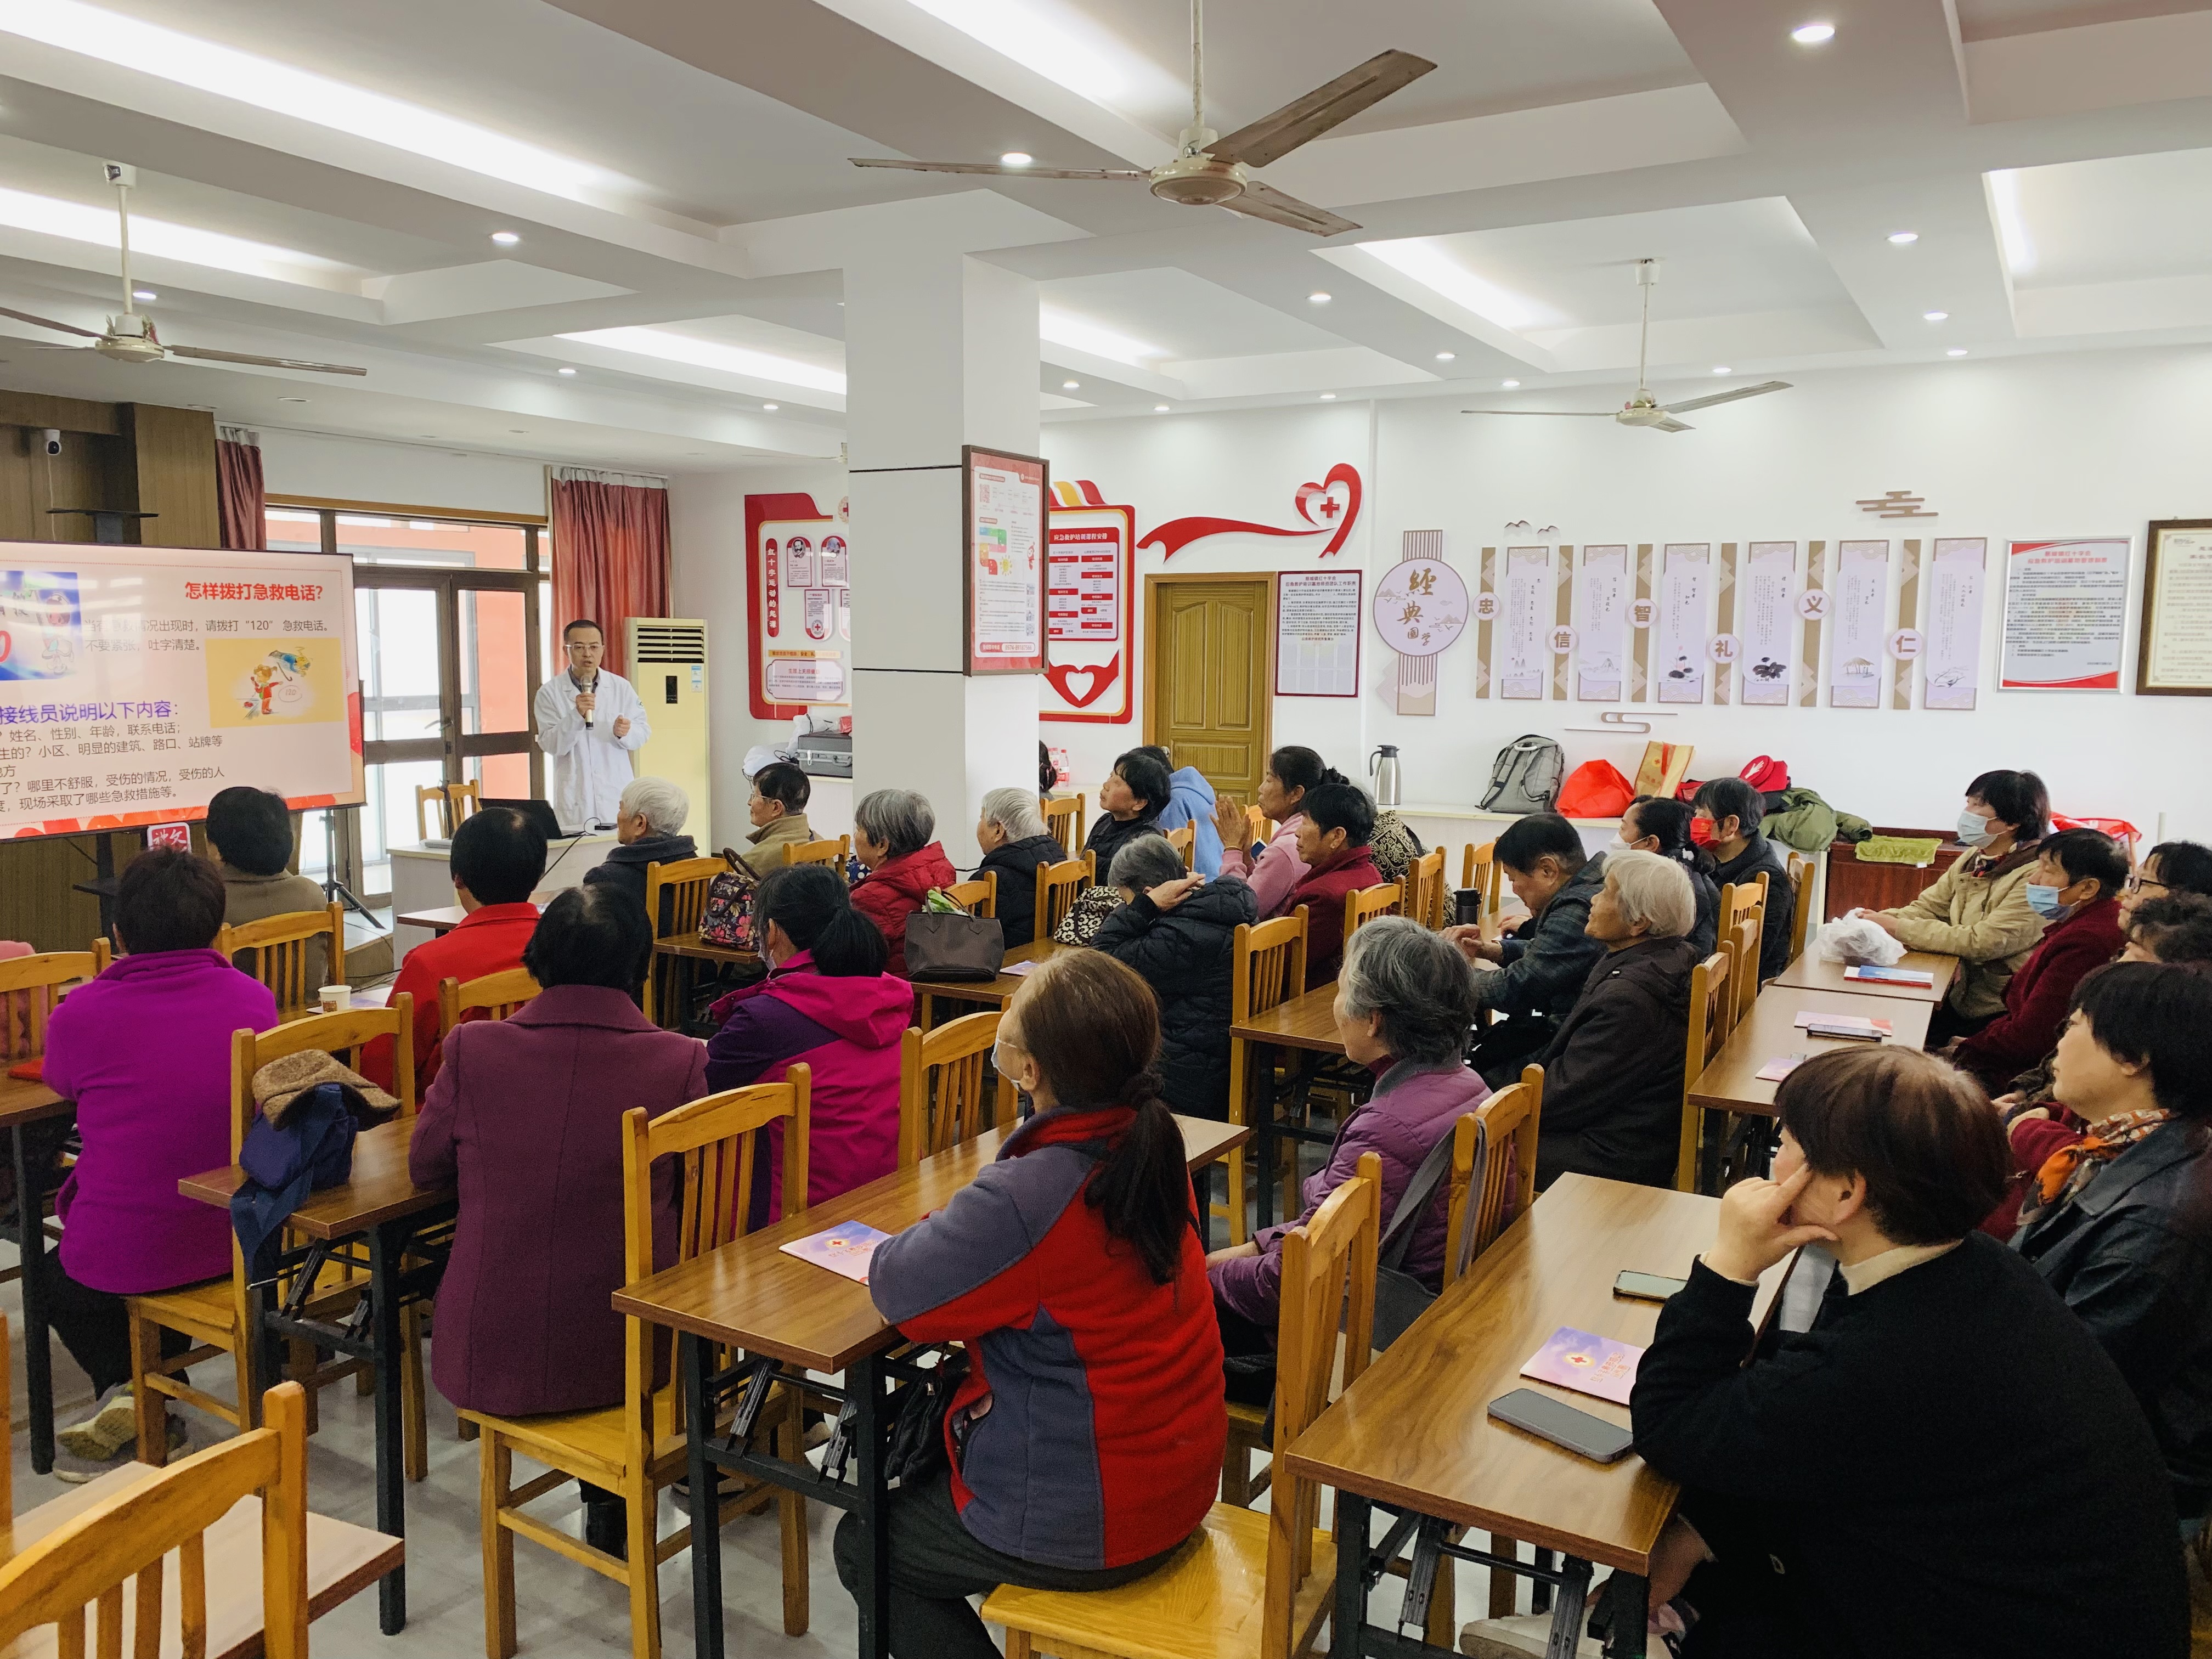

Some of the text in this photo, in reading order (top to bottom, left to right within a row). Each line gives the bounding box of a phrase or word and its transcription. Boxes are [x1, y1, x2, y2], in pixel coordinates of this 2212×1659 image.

[184, 582, 324, 601] 怎样拨打急救电话？
[768, 548, 777, 629] 红十字运动的起源
[1479, 598, 1494, 614] 忠
[1804, 595, 1822, 613] 义
[1634, 605, 1651, 622] 智
[1554, 632, 1571, 648] 信
[1715, 640, 1733, 657] 礼
[1896, 635, 1916, 652] 仁
[0, 723, 181, 742] 姓名、性别、年龄，联系电话；
